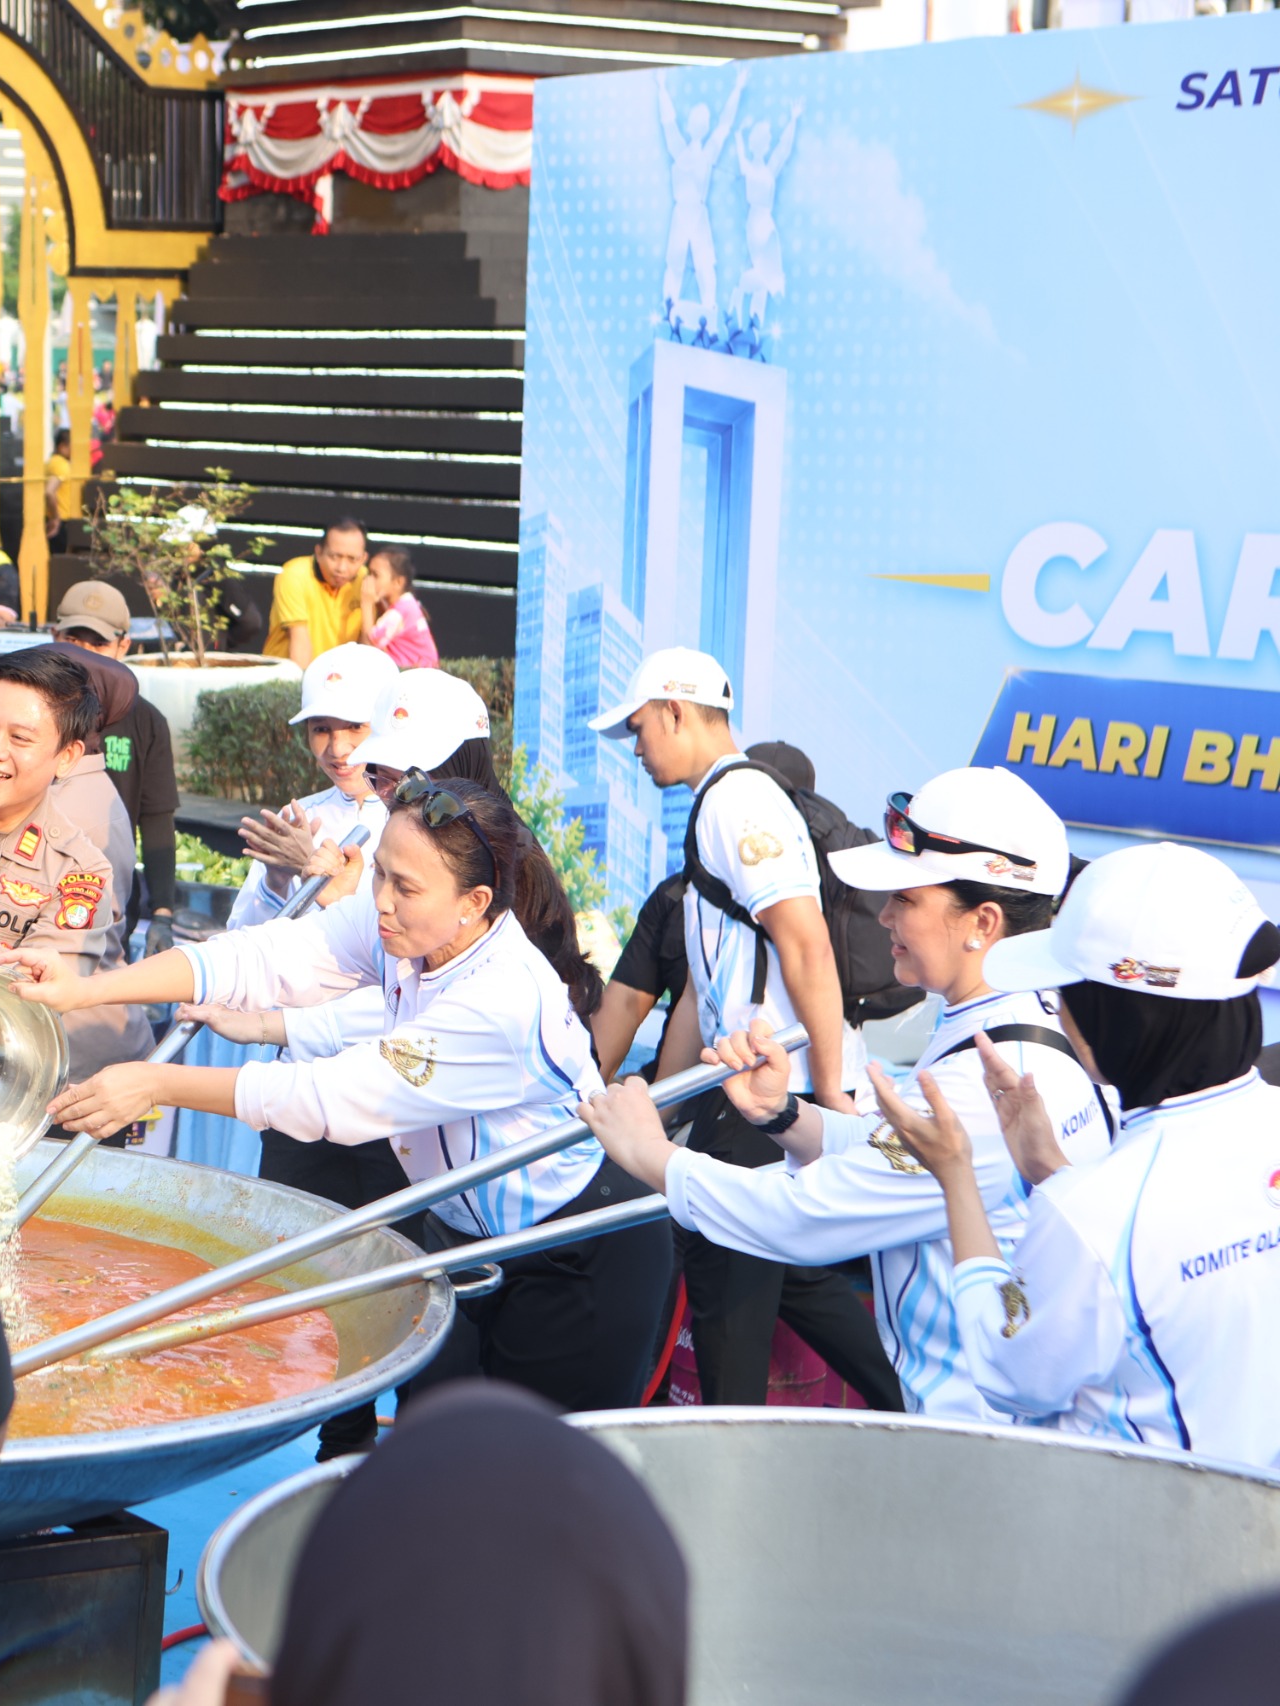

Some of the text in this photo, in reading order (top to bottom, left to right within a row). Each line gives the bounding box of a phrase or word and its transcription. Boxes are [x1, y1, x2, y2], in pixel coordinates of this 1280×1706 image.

[1175, 65, 1280, 111] SAT
[104, 735, 131, 754] THE
[1006, 711, 1280, 792] HARI BH
[60, 874, 101, 887] POLDA
[1180, 1226, 1280, 1282] KOMITE OL
